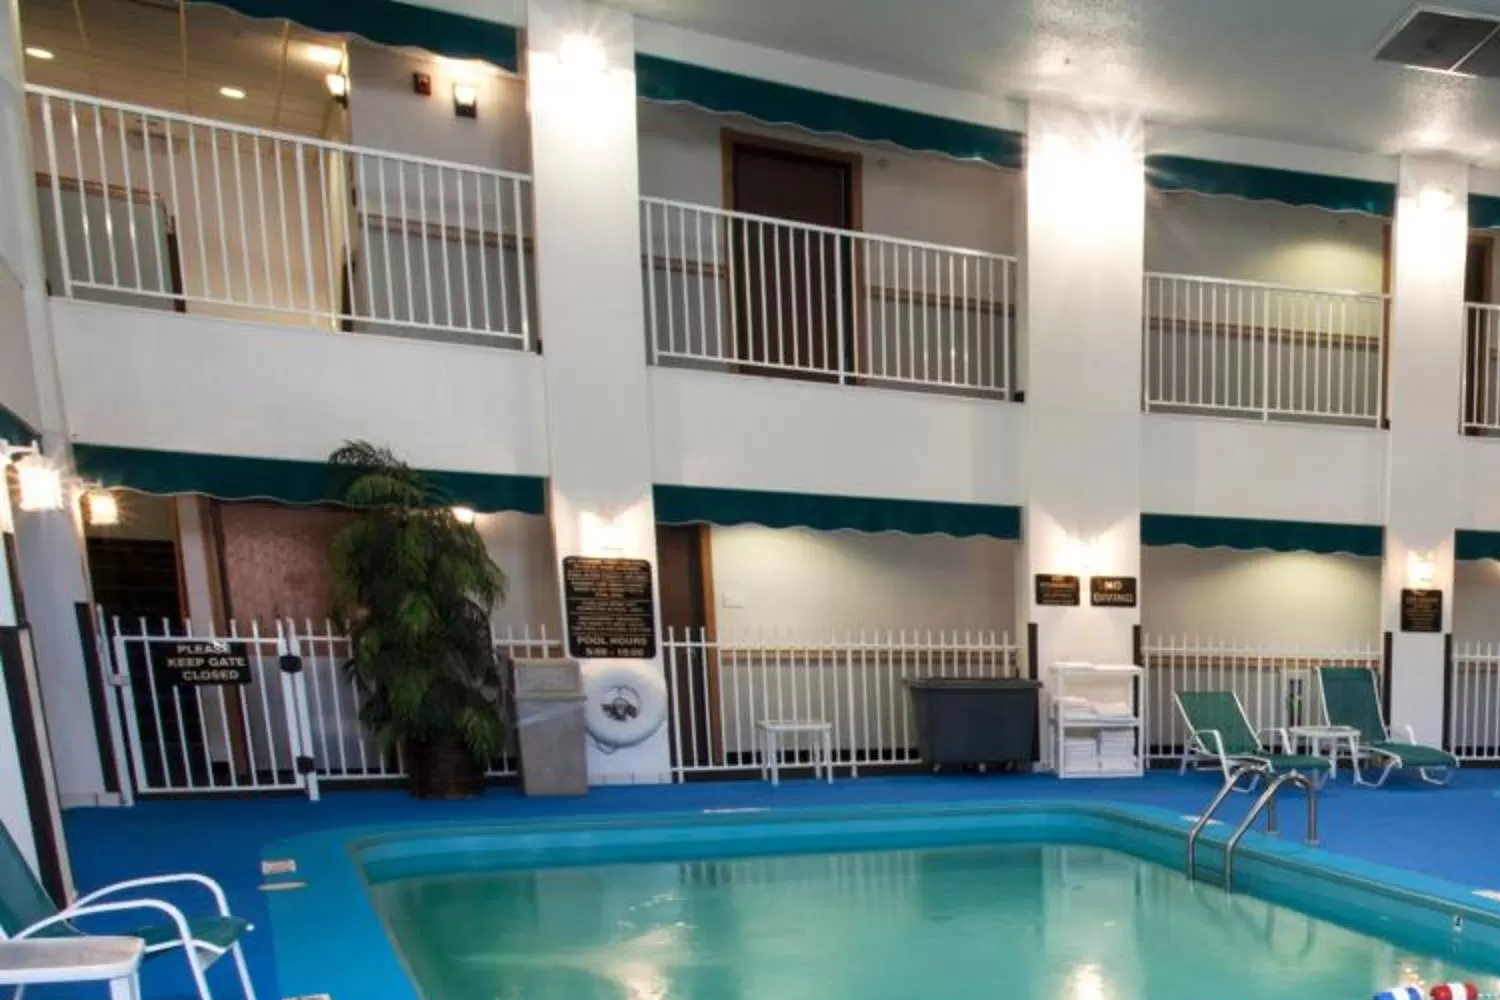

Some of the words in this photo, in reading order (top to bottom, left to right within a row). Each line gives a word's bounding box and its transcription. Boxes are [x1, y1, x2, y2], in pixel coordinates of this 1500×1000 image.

[1103, 580, 1123, 591] NO
[1093, 592, 1133, 603] DIVING
[576, 635, 609, 646] POOL
[609, 636, 648, 646] HOURS
[176, 643, 232, 654] PLEASE
[166, 656, 205, 668] KEEP
[207, 657, 246, 667] GATE
[182, 669, 240, 681] CLOSED
